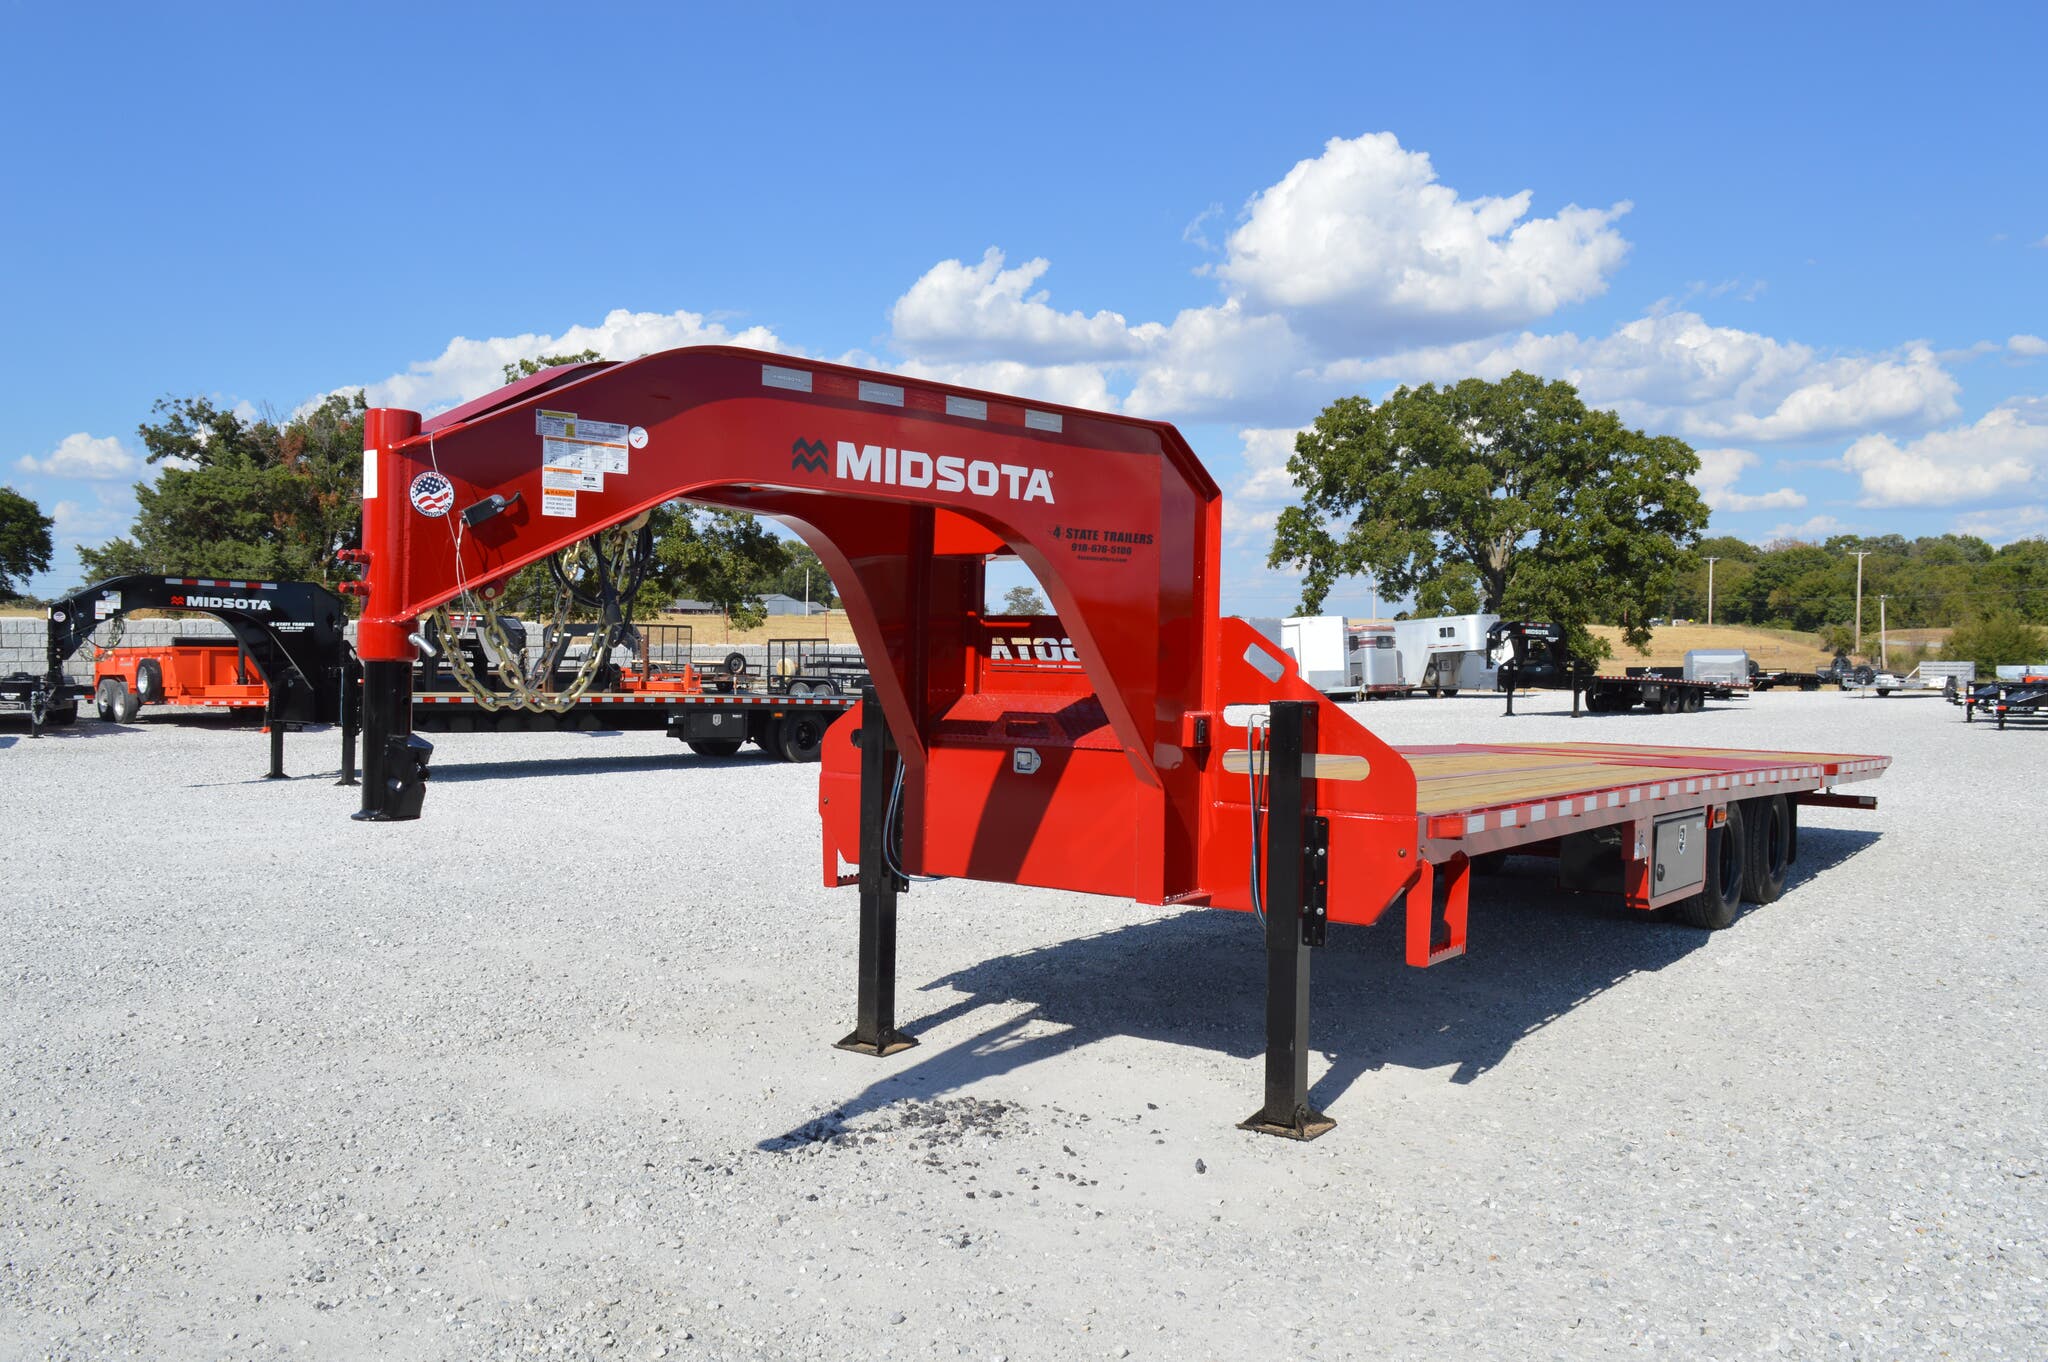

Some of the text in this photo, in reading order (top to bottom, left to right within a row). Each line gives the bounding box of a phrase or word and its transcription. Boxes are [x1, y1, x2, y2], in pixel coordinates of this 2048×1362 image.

[836, 441, 1055, 504] MIDSOTA
[1053, 526, 1154, 545] 4 STATE TRAILERS
[186, 595, 272, 611] MIDSOTA
